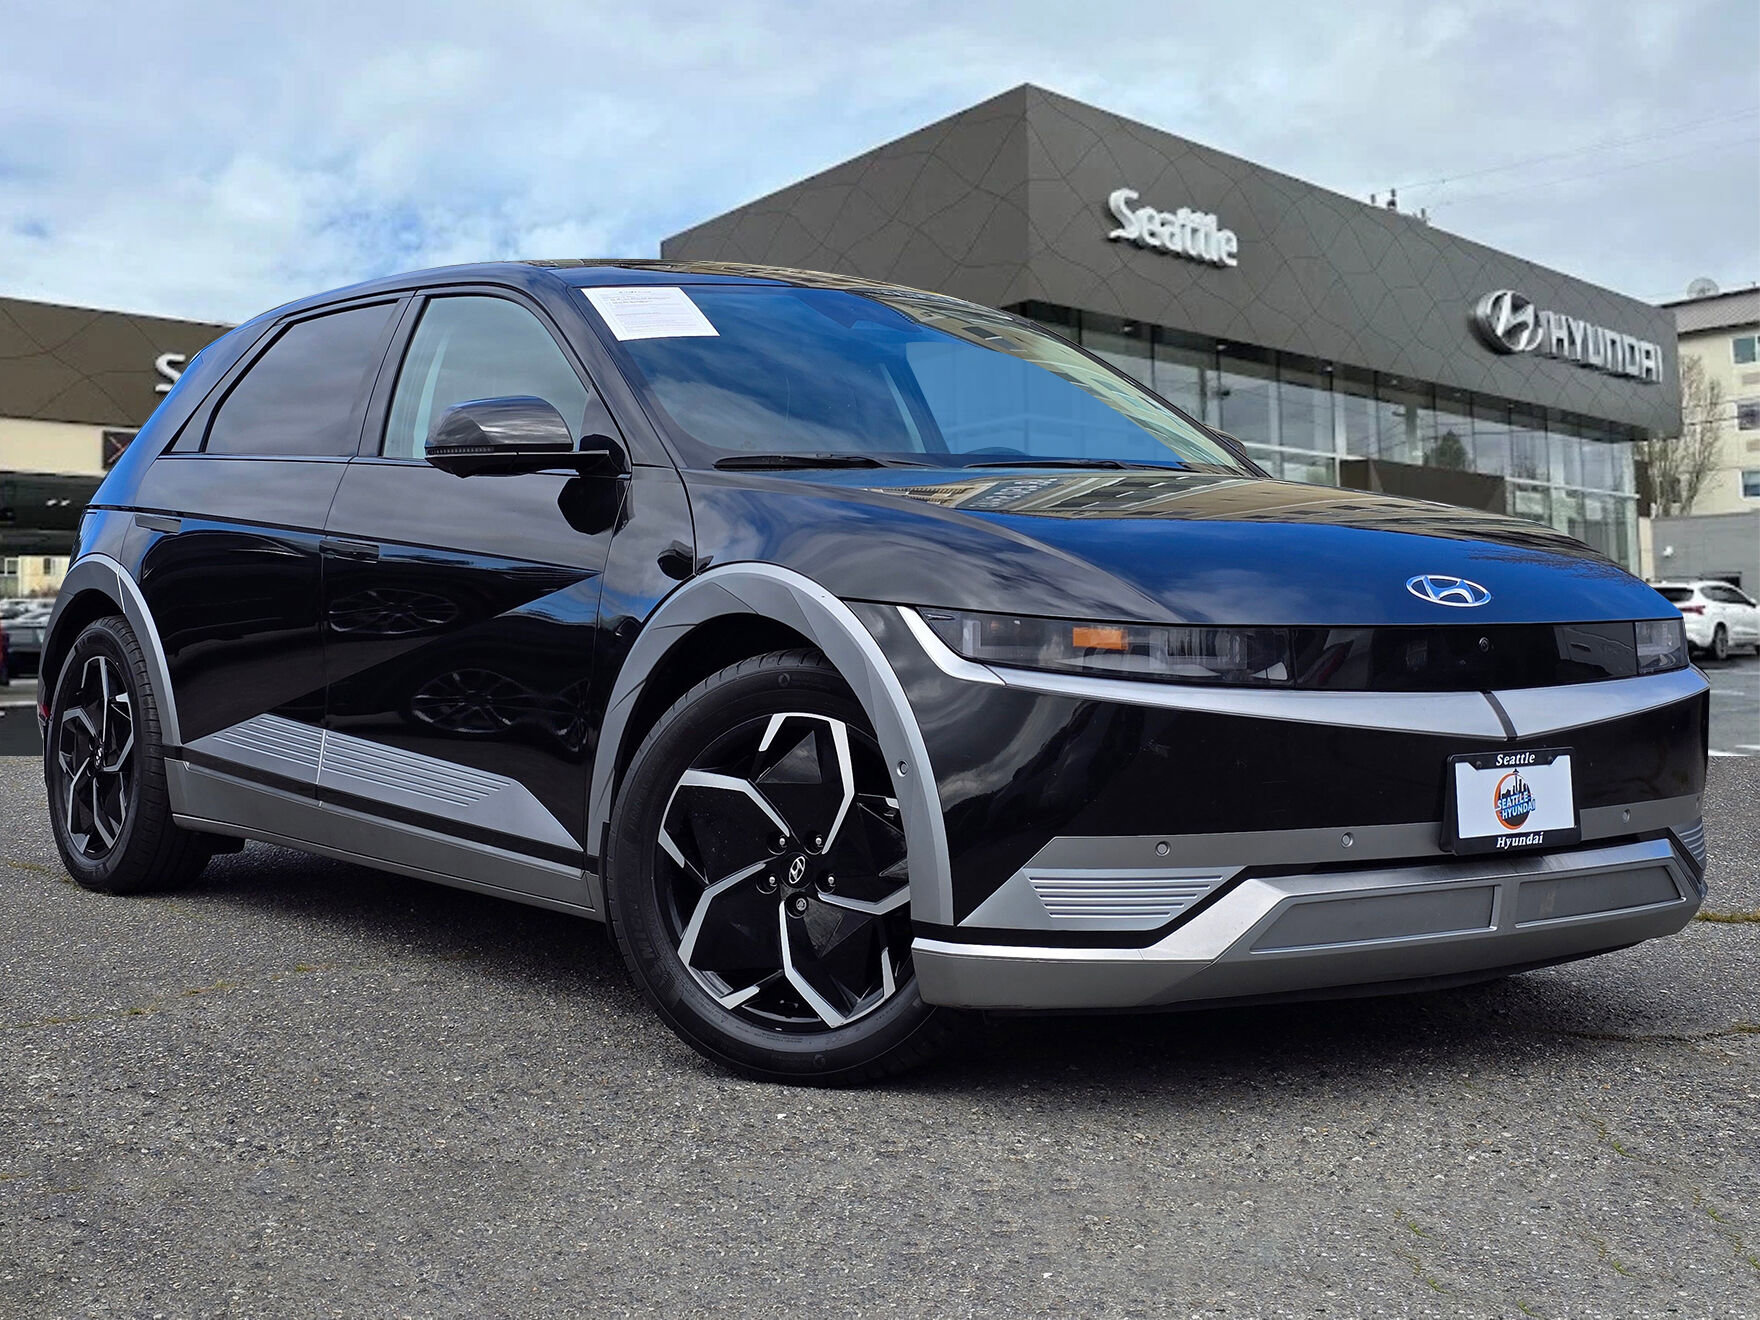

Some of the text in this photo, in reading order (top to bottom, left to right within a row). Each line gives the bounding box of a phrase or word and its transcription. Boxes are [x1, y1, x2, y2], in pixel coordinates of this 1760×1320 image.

[1108, 187, 1238, 267] Seattle
[1541, 311, 1663, 382] HYUNDAI
[155, 350, 201, 392] S
[1496, 752, 1535, 766] Seattle
[1497, 791, 1530, 810] SEATTLE
[1502, 799, 1536, 819] HYUNDAI
[1496, 832, 1543, 849] Hyundai
